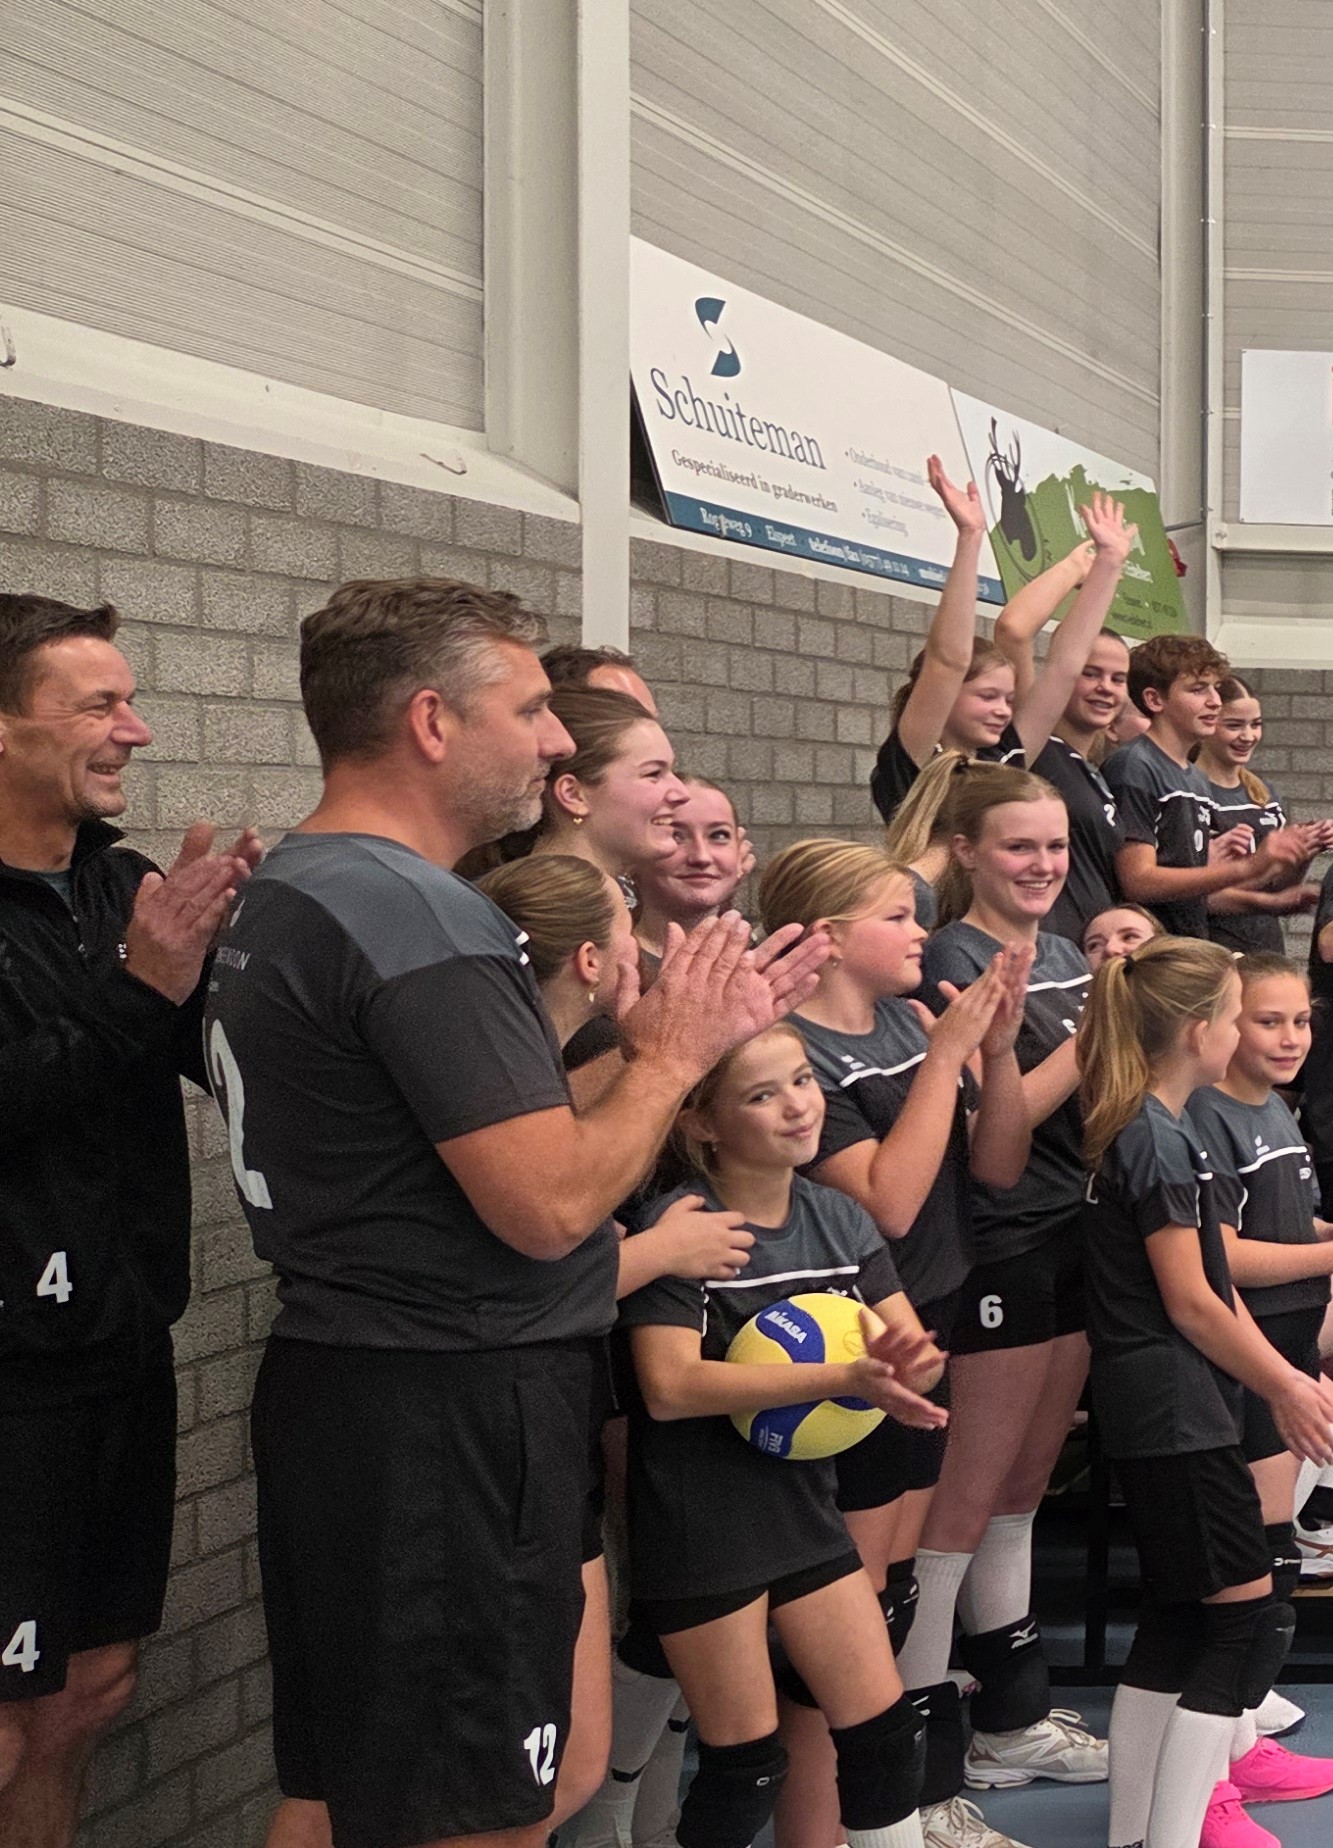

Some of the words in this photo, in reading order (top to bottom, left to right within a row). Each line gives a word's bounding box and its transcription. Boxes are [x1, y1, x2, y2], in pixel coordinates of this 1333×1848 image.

[650, 367, 827, 470] Schuiteman
[36, 1251, 73, 1303] 4
[765, 1310, 808, 1344] MIKASA
[979, 1294, 1003, 1329] 6
[1, 1620, 41, 1672] 4
[523, 1723, 557, 1786] 12
